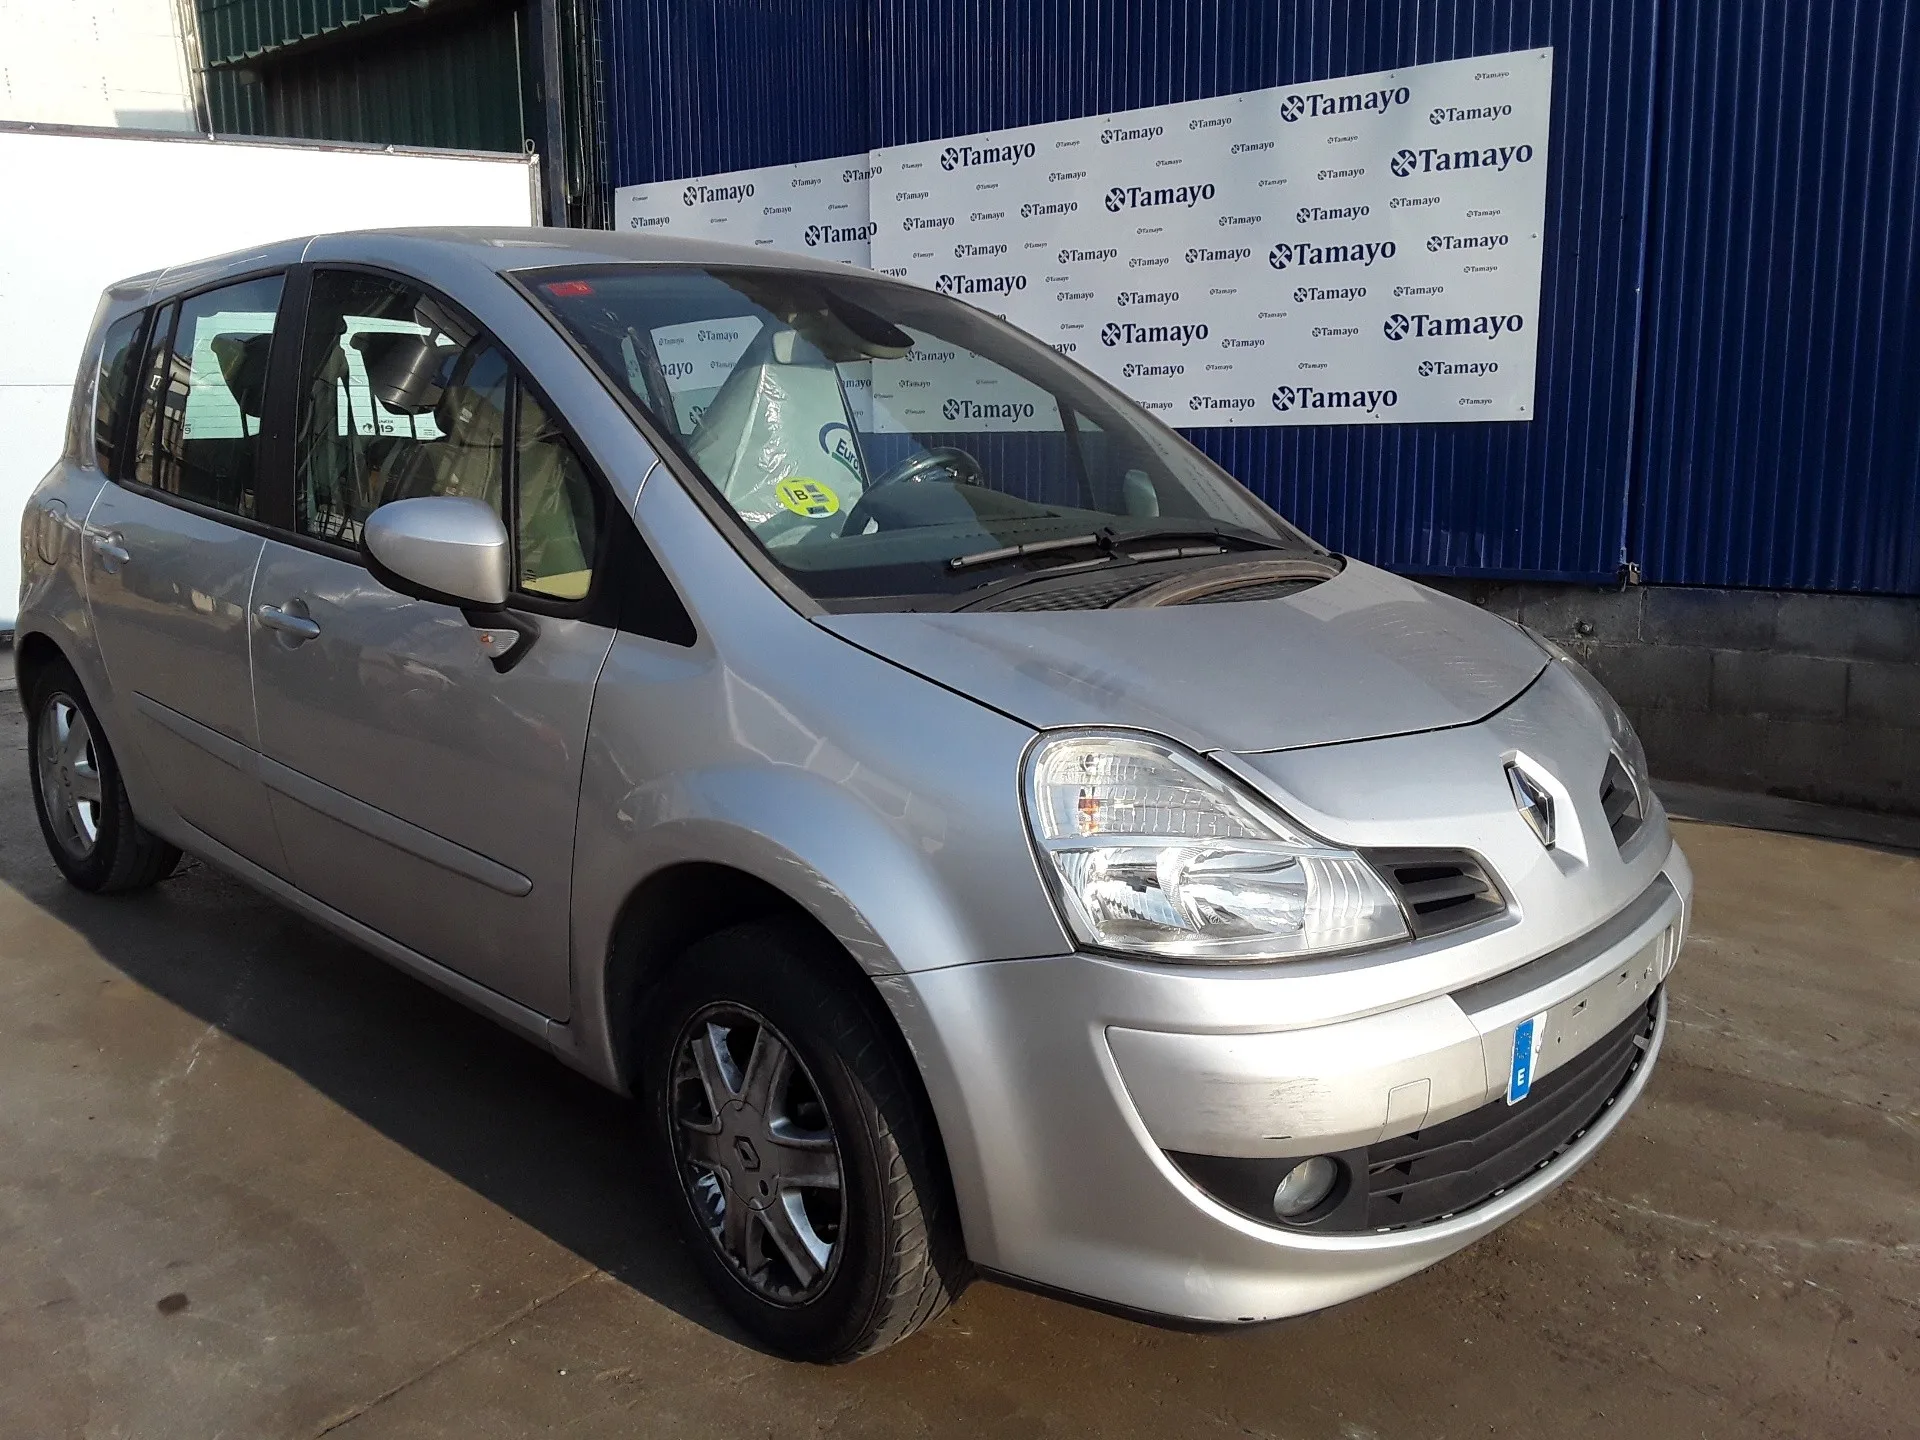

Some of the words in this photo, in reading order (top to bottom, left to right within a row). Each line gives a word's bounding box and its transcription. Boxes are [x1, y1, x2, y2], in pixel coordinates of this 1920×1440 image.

[1307, 87, 1409, 117] Tamayo
[1446, 105, 1511, 122] Tamayo
[1198, 118, 1231, 129] Tamayo
[1114, 127, 1163, 142] Tamayo
[1240, 142, 1274, 152] Tamayo
[960, 142, 1036, 168] Tamayo
[1419, 145, 1532, 172] Tamayo
[1327, 169, 1364, 179] Tamayo
[698, 184, 754, 203] Tamayo
[1127, 184, 1215, 208] Tamayo
[1032, 202, 1077, 215] Tamayo
[1400, 197, 1440, 207] Tamayo
[1311, 206, 1369, 221] Tamayo
[637, 217, 669, 227] Tamayo
[914, 217, 954, 230] Tamayo
[1443, 235, 1508, 250] Tamayo
[965, 245, 1007, 257] Tamayo
[1070, 249, 1117, 262] Tamayo
[1199, 248, 1250, 262] Tamayo
[1294, 242, 1396, 266] Tamayo
[953, 274, 1027, 297] Tamayo
[1130, 292, 1179, 305] Tamayo
[1308, 288, 1366, 301] Tamayo
[1411, 315, 1523, 339] Tamayo
[705, 331, 738, 342] Tamayo
[1122, 324, 1208, 346] Tamayo
[915, 351, 955, 363] Tamayo
[1135, 364, 1184, 378] Tamayo
[1434, 362, 1498, 376] Tamayo
[1141, 401, 1173, 411] Tamayo
[1201, 397, 1255, 412] Tamayo
[1297, 387, 1398, 412] Tamayo
[960, 400, 1035, 423] Tamayo
[793, 490, 808, 500] B
[1517, 1067, 1526, 1087] E
